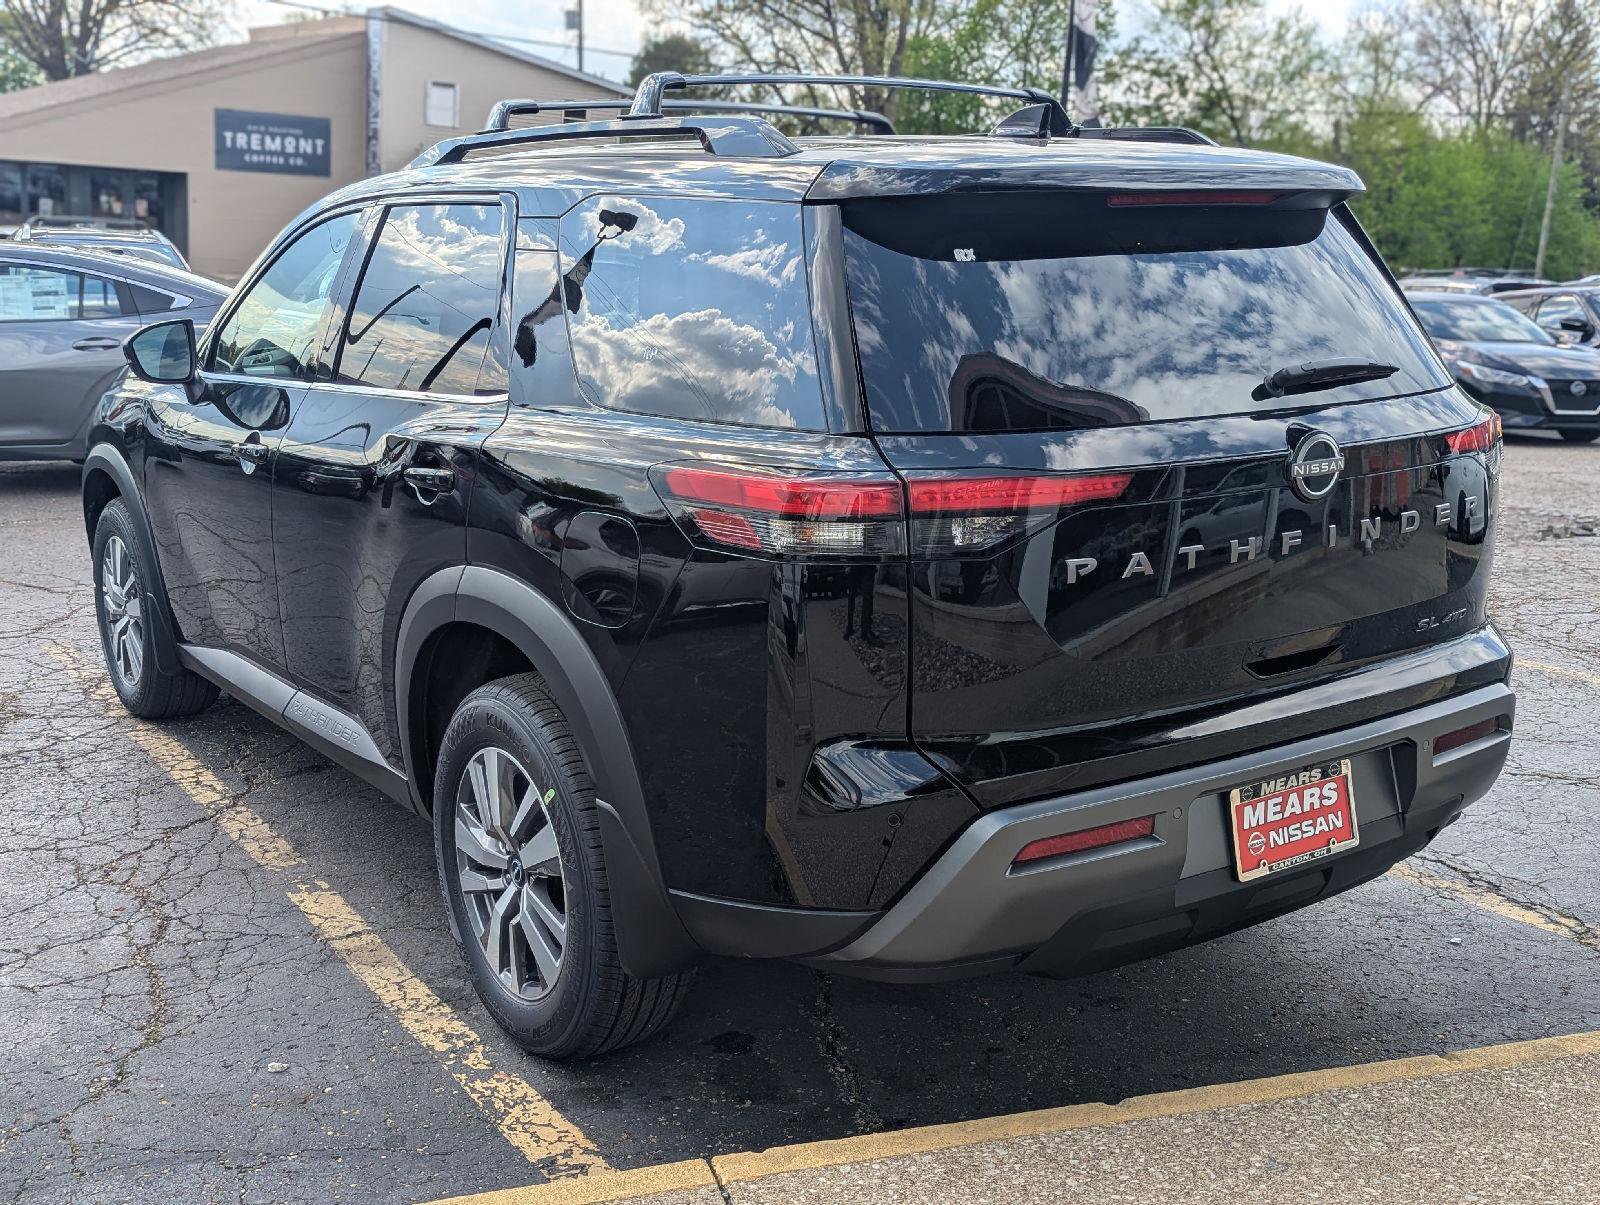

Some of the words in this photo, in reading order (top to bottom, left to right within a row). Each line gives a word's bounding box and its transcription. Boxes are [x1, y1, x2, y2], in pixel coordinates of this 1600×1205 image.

[223, 131, 325, 155] TREMONT
[1294, 460, 1344, 476] NISSAN
[1066, 495, 1478, 585] PATHFINDER
[1415, 616, 1440, 632] SL
[1260, 768, 1322, 796] MEARS
[1243, 781, 1338, 830] MEARS
[1268, 810, 1343, 848] NISSAN
[1272, 853, 1313, 871] CANTON,
[1314, 848, 1328, 860] OH
